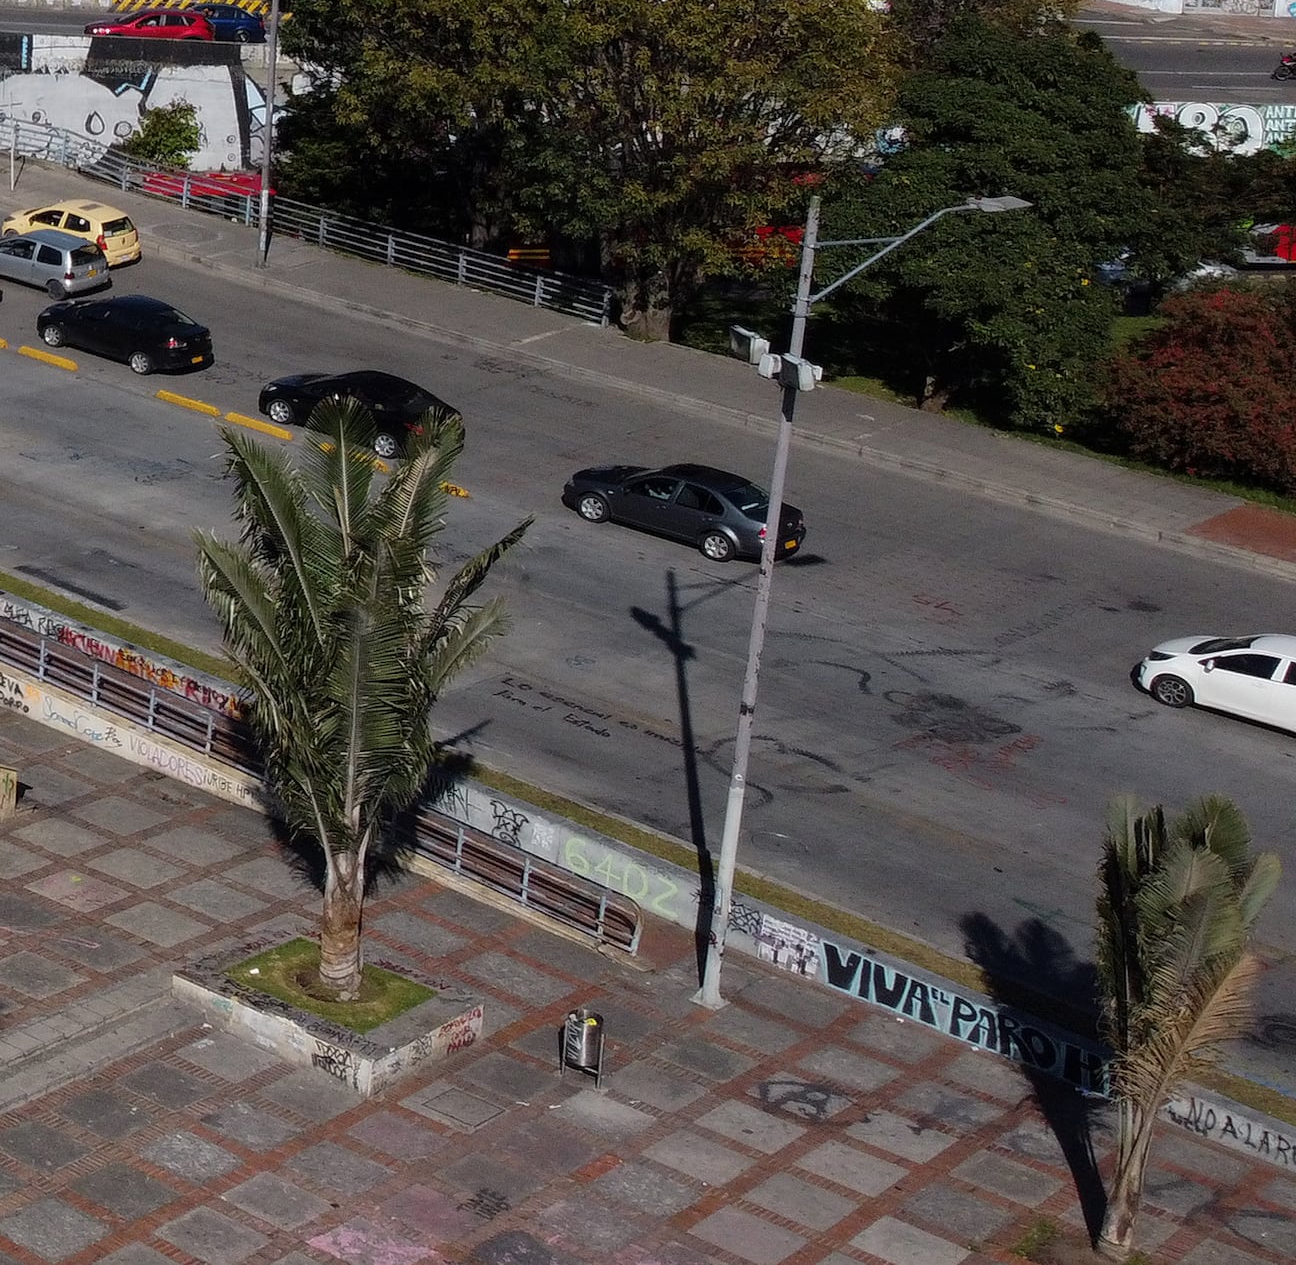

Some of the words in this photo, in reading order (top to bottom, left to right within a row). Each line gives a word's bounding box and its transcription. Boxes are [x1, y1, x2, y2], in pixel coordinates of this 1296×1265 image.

[563, 835, 681, 921] 6402
[823, 941, 937, 1027] VIVA
[931, 987, 949, 1005] EL
[949, 994, 1058, 1070] PARO
